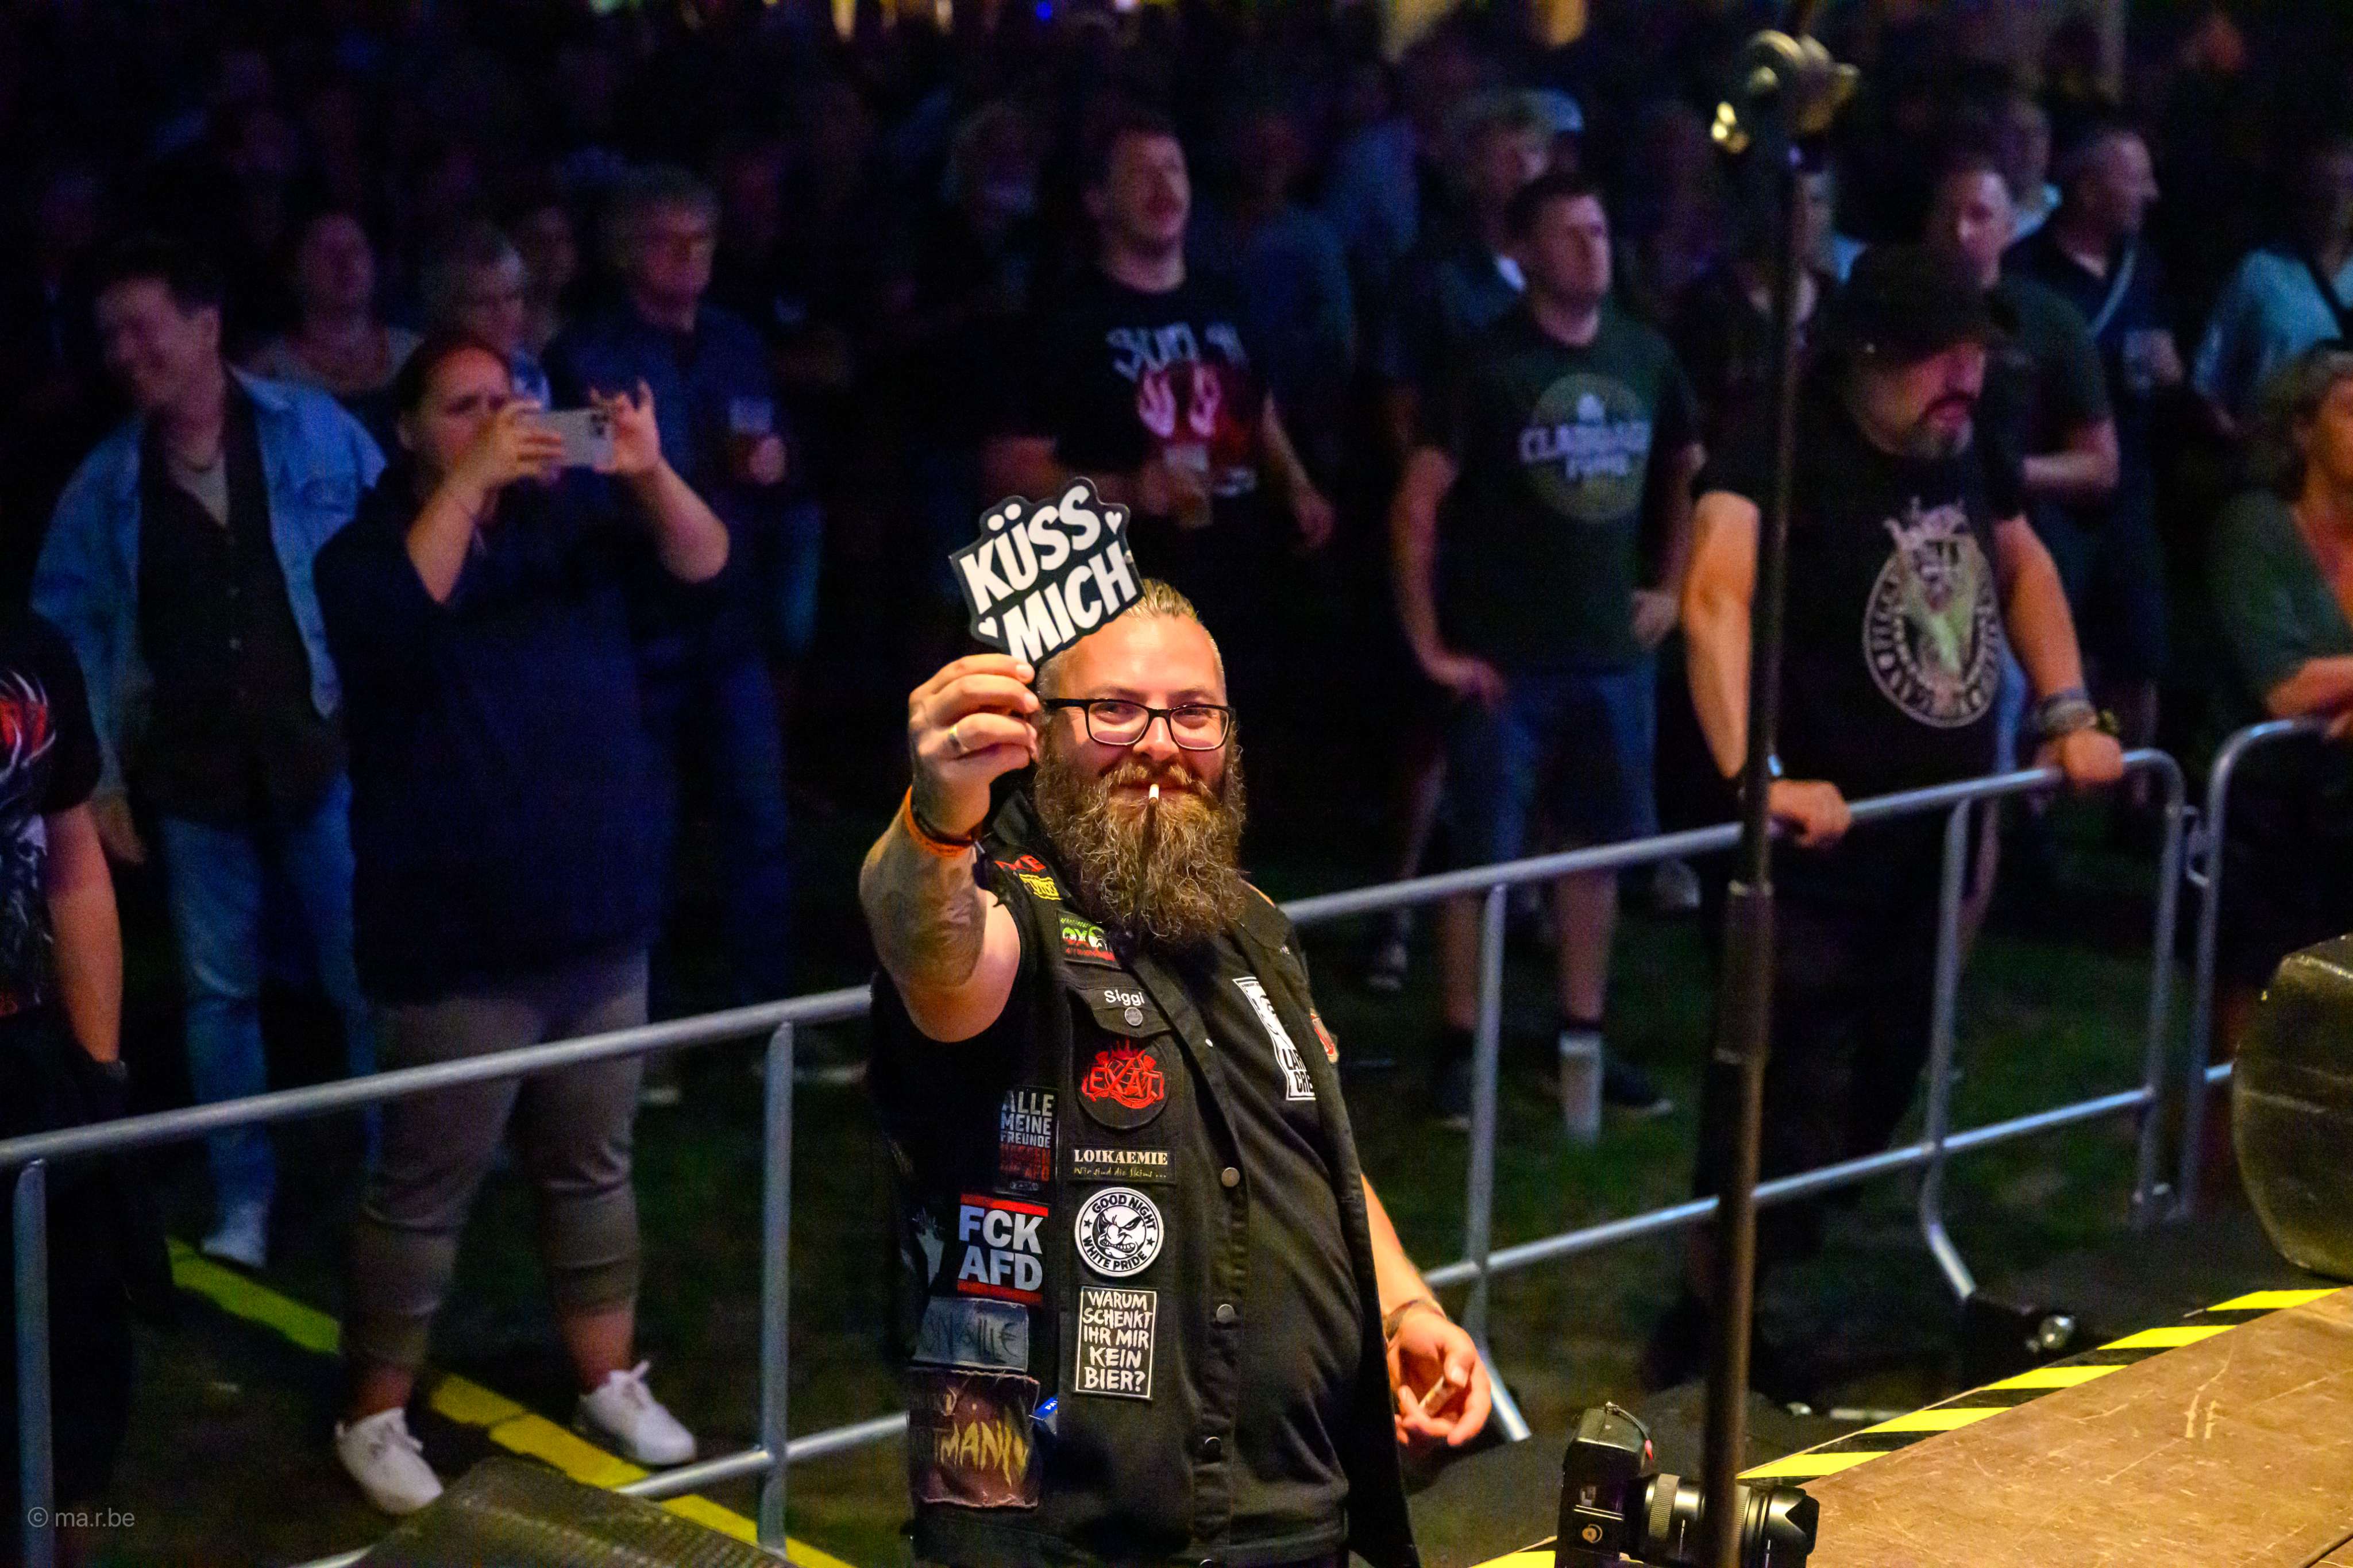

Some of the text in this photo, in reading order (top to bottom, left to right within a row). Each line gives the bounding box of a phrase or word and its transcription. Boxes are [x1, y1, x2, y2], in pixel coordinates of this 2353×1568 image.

[959, 485, 1101, 615] KÜSS
[1002, 540, 1137, 666] MICH
[1104, 989, 1145, 1006] Siggi
[1001, 1090, 1054, 1117] ALLE
[1000, 1110, 1053, 1136] MEINE
[1000, 1129, 1051, 1149] FREUNDE
[1074, 1149, 1168, 1165] LOIKAEMIE
[1074, 1167, 1091, 1176] Wir
[1093, 1167, 1112, 1176] sind
[1092, 1195, 1156, 1230] GOOD NIGHT
[959, 1204, 1044, 1254] FCK
[1082, 1235, 1147, 1270] WHITE PRIDE
[958, 1245, 1043, 1291] AFD
[1087, 1290, 1148, 1311] WARUM
[1082, 1307, 1153, 1329] SCHENKT
[1083, 1325, 1149, 1350] IHR MIR
[1089, 1346, 1142, 1369] KEIN
[1084, 1366, 1146, 1392] BIER?
